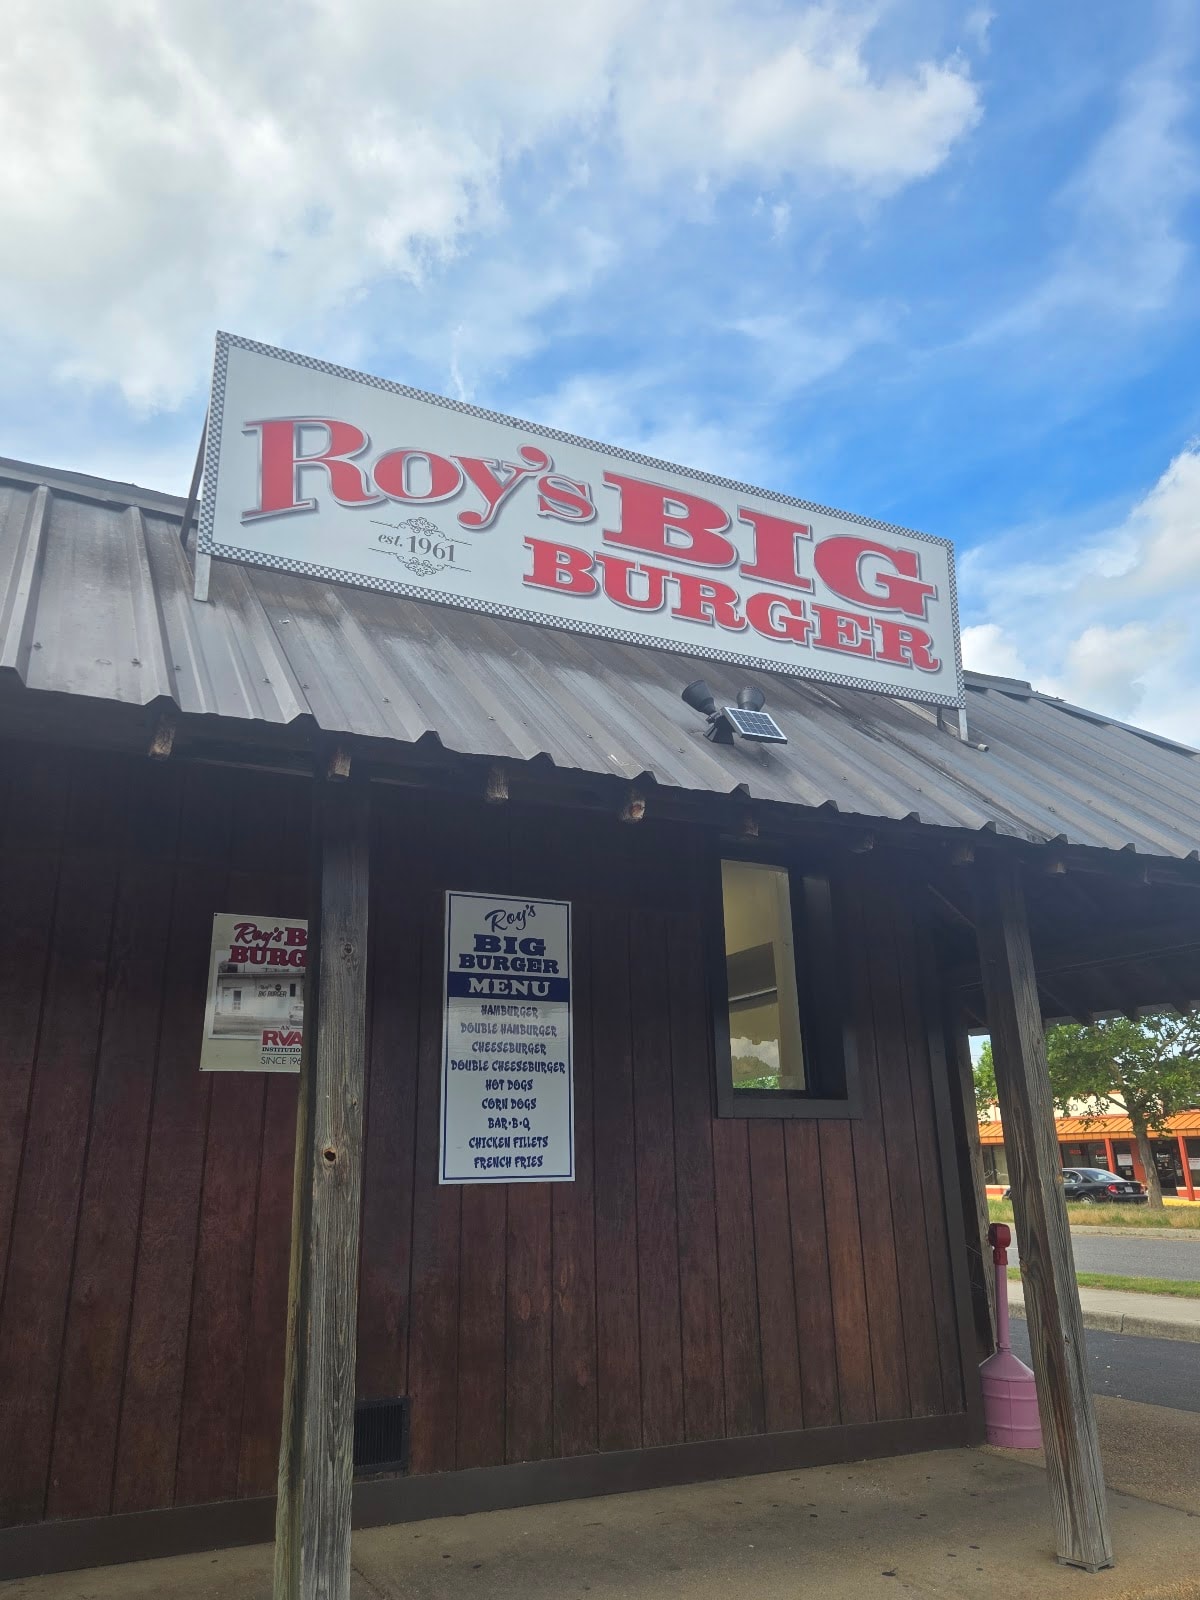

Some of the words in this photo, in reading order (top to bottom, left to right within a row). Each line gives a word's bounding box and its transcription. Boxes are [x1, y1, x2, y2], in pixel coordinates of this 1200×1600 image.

[241, 414, 597, 530] Roy's
[602, 470, 938, 620] BIG
[378, 533, 403, 548] est.
[406, 535, 456, 563] 1961
[523, 536, 941, 673] BURGER
[484, 904, 537, 933] Roy's
[234, 922, 284, 949] Roy's
[473, 933, 547, 957] BIG
[228, 945, 308, 968] BURG
[459, 953, 560, 975] BURGER
[468, 977, 551, 997] MENU
[481, 1004, 539, 1019] HAMBURGER
[262, 1030, 304, 1047] RVA
[460, 1022, 498, 1035] DOUBLE
[501, 1023, 558, 1038] HAMBURGER
[471, 1041, 547, 1055] CHEESEBURGER
[261, 1056, 287, 1065] SINCE
[289, 1056, 302, 1066] 196
[450, 1060, 489, 1072] DOUBLE
[491, 1060, 566, 1074] CHEESEBURGER
[485, 1079, 505, 1091] HOT
[507, 1078, 534, 1092] DOGS
[481, 1098, 508, 1111] CORN
[510, 1097, 537, 1111] DOGS
[468, 1136, 511, 1150] CHICKEN
[513, 1135, 549, 1149] FILLETS
[474, 1155, 512, 1170] FRENCH
[514, 1154, 544, 1169] FRIES
